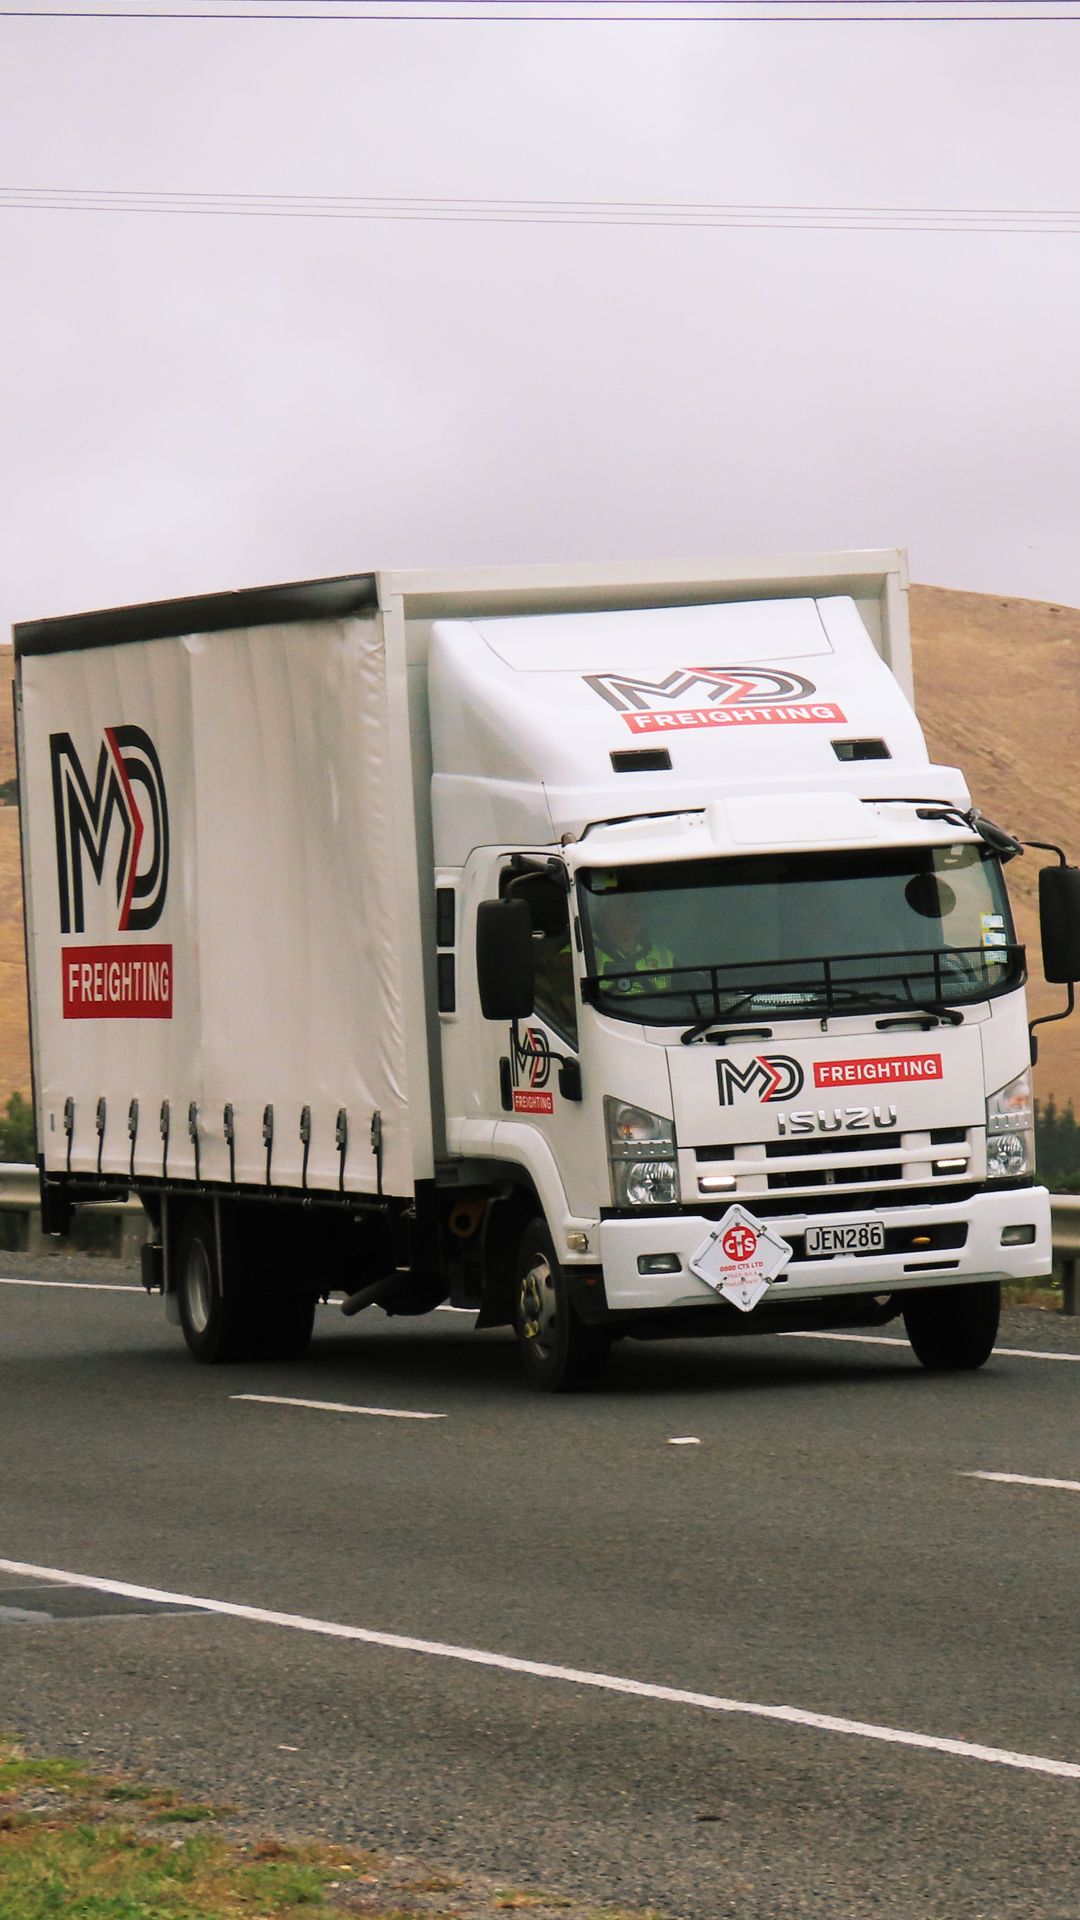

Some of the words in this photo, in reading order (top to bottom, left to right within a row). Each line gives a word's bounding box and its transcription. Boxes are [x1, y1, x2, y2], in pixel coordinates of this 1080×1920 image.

[581, 666, 817, 712] MD
[633, 706, 837, 729] FREIGHTING
[49, 724, 170, 934] MD
[68, 960, 170, 1003] FREIGHTING
[715, 1054, 805, 1107] MD
[819, 1059, 938, 1083] FREIGHTING
[515, 1094, 552, 1110] FREIGHTING
[776, 1104, 898, 1136] ISUZU
[725, 1230, 755, 1257] CTS
[809, 1226, 882, 1251] JEN286
